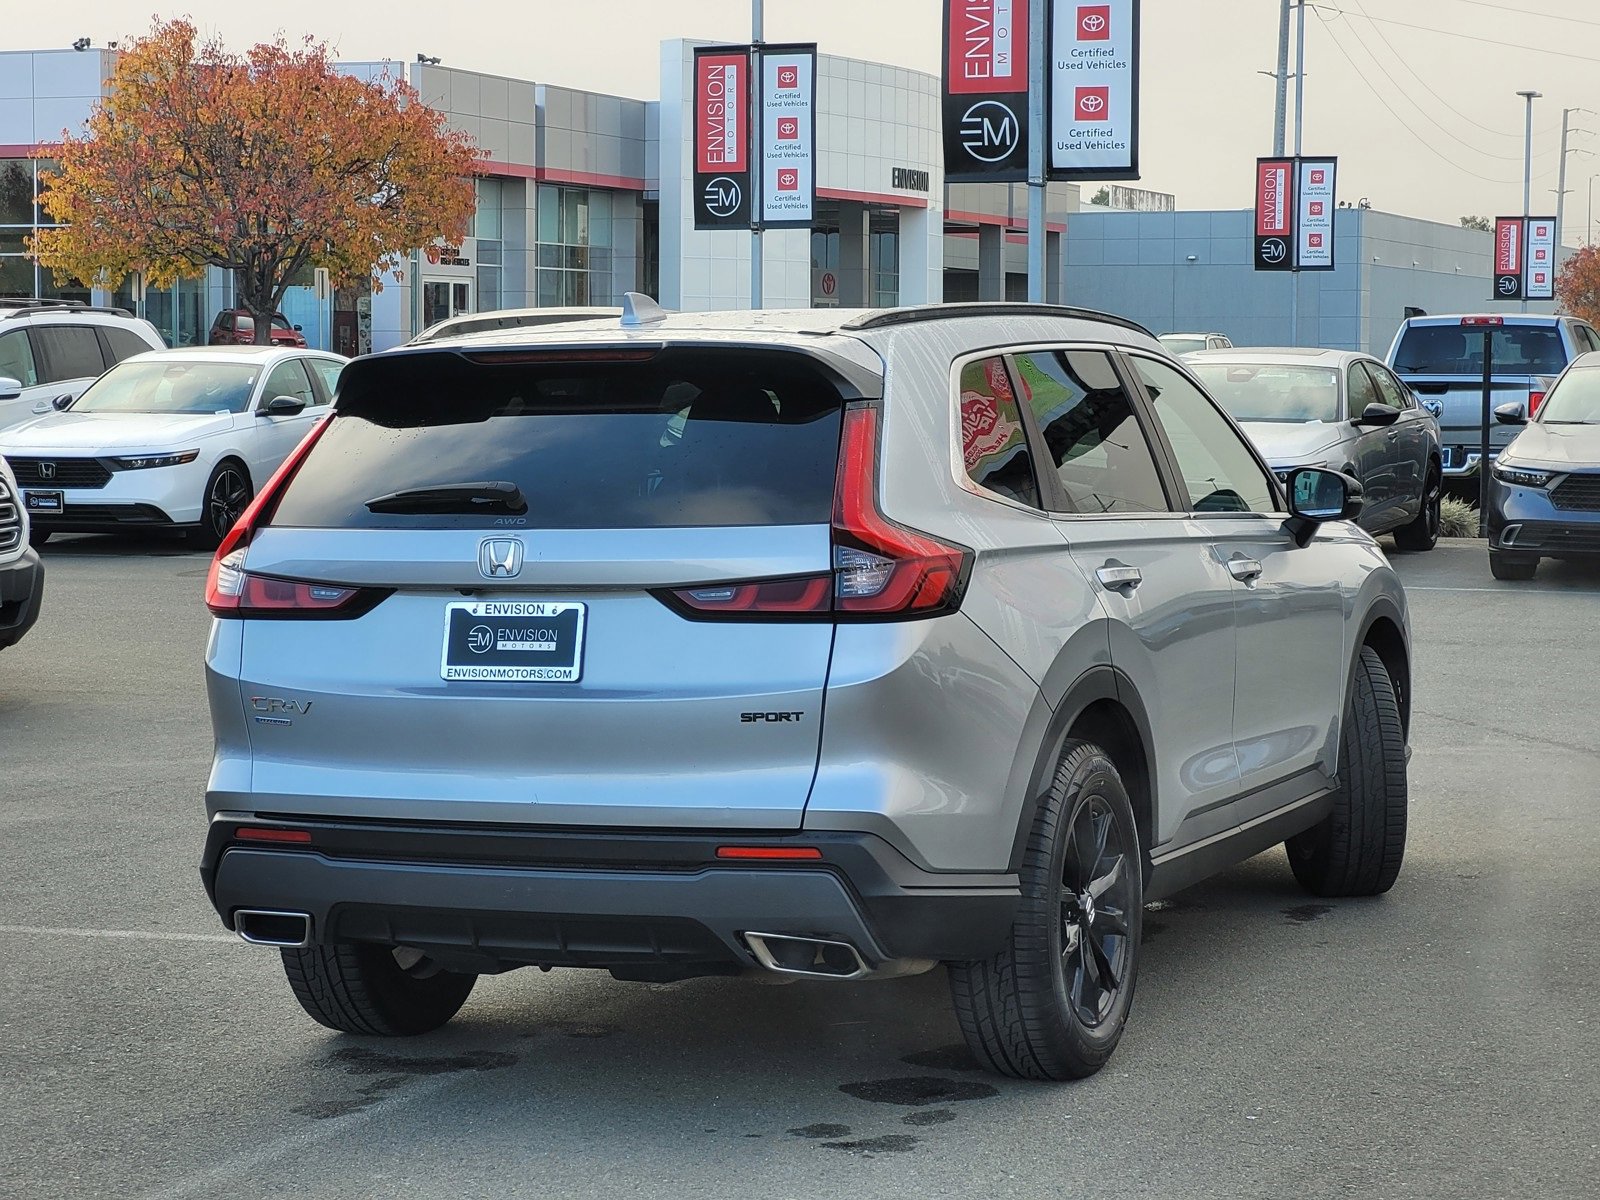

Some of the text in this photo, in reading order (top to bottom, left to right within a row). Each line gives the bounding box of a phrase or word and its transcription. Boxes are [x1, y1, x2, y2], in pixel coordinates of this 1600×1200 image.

[965, 0, 990, 78] ENVI
[1070, 48, 1115, 57] Certified
[1057, 60, 1127, 70] Used Vehicles
[707, 65, 724, 163] ENVISION
[727, 74, 735, 154] MOTORS
[1069, 128, 1113, 138] Certified
[1057, 141, 1126, 150] Used Vehicles
[892, 166, 929, 192] ENVISION
[1264, 168, 1276, 230] ENVISION
[1501, 225, 1510, 271] ENVISION
[484, 603, 545, 615] ENVISION
[497, 628, 558, 642] ENVISION
[446, 668, 573, 679] ENVISIONMOTORS.COM
[251, 696, 313, 715] CR-V
[740, 711, 804, 723] SPORT
